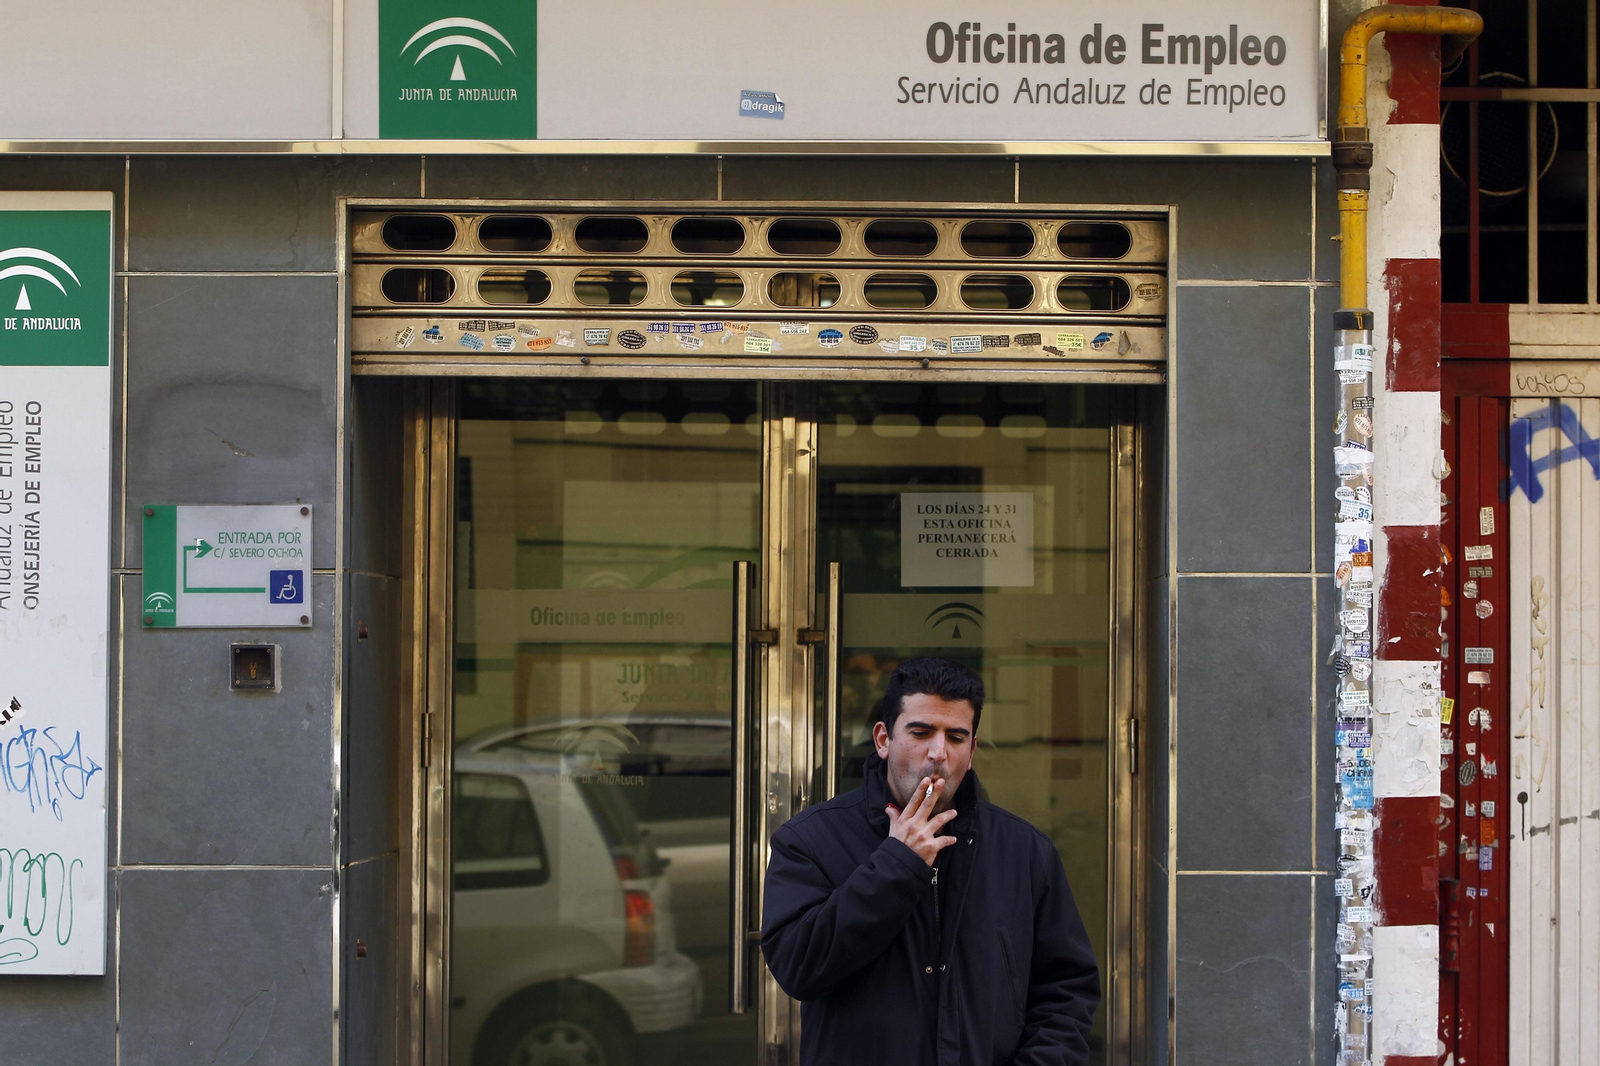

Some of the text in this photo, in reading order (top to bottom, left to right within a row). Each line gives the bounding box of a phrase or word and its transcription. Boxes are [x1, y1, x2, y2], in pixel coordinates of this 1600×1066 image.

[926, 22, 1287, 75] Oficina de Empleo
[398, 88, 518, 101] JUNTA DE ANDALUCIA
[896, 76, 1287, 113] Servicio Andaluz de Empleo
[4, 317, 82, 330] DE ANDALUCIA
[25, 400, 42, 474] EMPLEO
[25, 480, 41, 504] DE
[917, 502, 1017, 515] LOS DÍAS 24 Y 31
[1358, 507, 1369, 520] 35
[923, 518, 1012, 529] ESTA OFICINA
[218, 531, 302, 544] ENTRADA POR
[917, 530, 1017, 543] PERMANECERÁ
[214, 547, 304, 558] C/ SEVERO OCHOA
[936, 547, 999, 558] CERRADA
[530, 607, 686, 630] Oficina de Empleo
